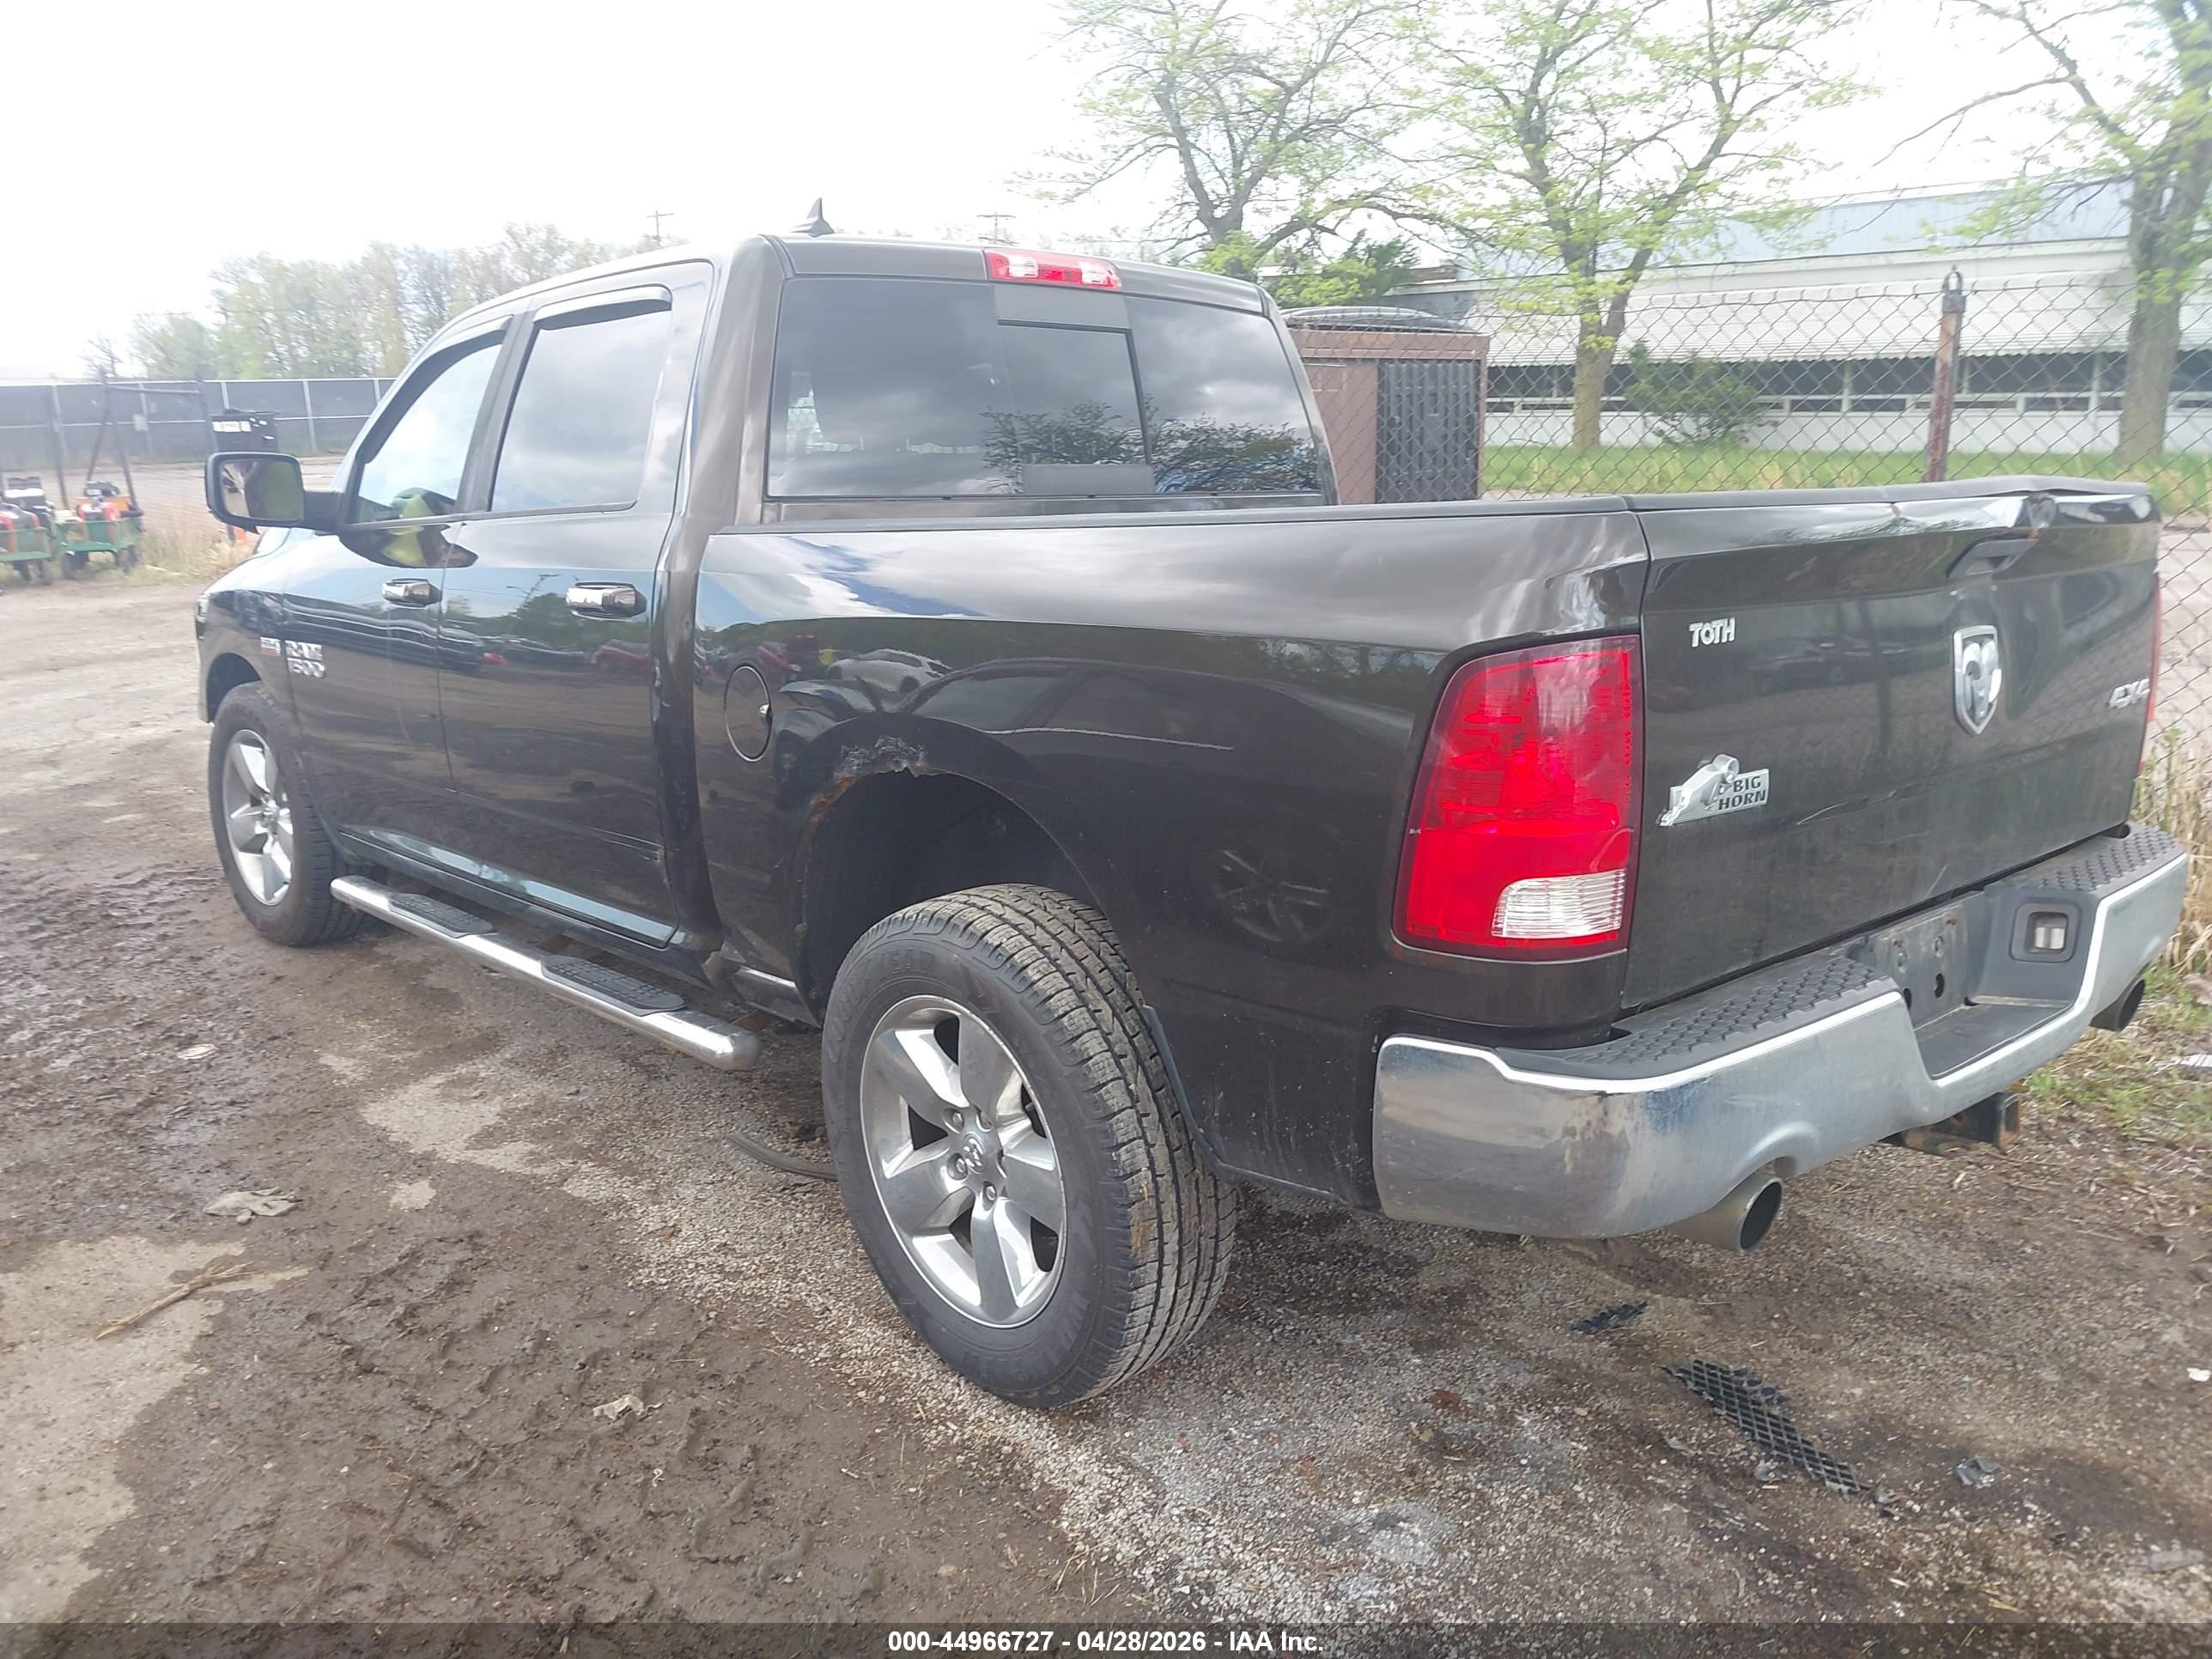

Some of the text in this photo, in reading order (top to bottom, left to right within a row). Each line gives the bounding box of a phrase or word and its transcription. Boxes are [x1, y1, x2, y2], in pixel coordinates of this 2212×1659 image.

[1689, 617, 1735, 647] TOTH
[1732, 775, 1762, 793] BIG
[1717, 789, 1767, 811] HORN
